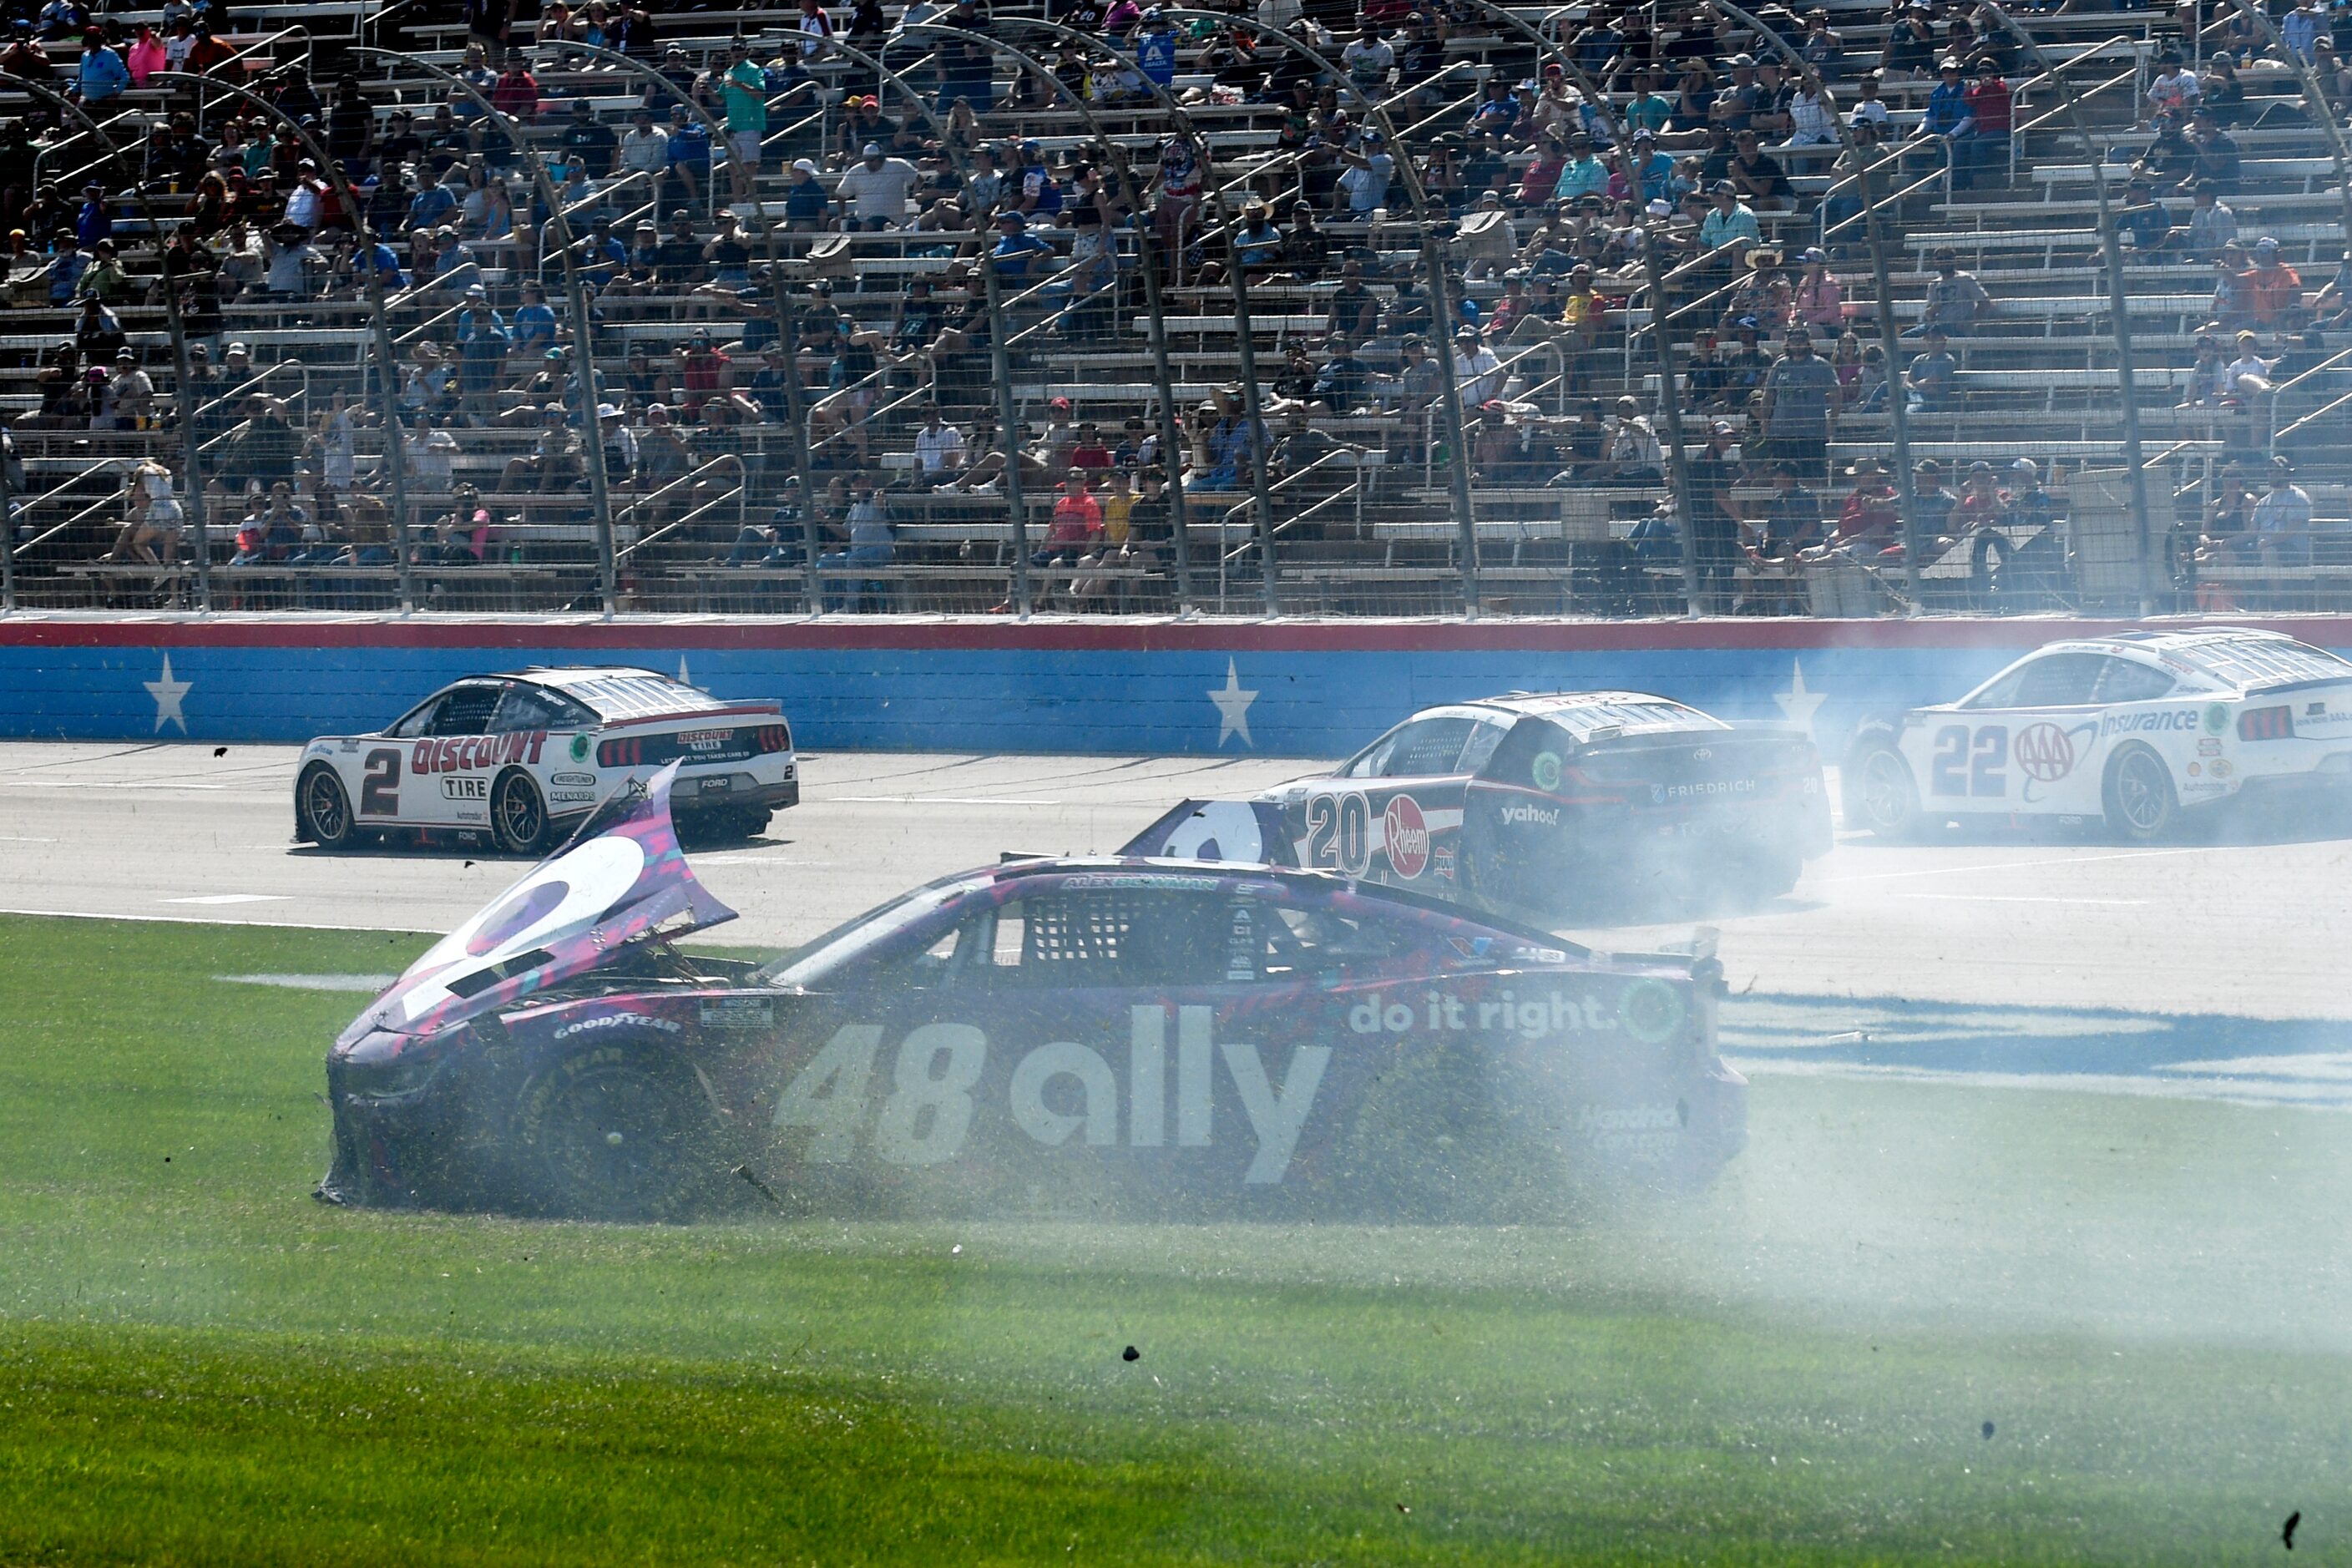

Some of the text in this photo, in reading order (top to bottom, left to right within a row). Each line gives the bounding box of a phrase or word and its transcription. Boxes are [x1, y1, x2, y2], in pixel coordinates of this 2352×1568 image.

[677, 730, 734, 744] DISCOUNT
[2100, 710, 2198, 737] Insurance
[412, 730, 548, 775] DISCOUNT
[692, 741, 721, 751] TIRE
[2017, 722, 2071, 781] AAA
[784, 765, 793, 780] 2
[1930, 725, 2007, 797] 22
[360, 747, 402, 817] 2
[445, 779, 486, 797] TIRE
[701, 778, 728, 789] FORD
[1667, 780, 1755, 798] FRIEDRICH
[1803, 777, 1818, 794] 20
[550, 792, 594, 802] MENARDS
[1501, 804, 1560, 826] yahoo!
[1308, 790, 1370, 876] 20
[1386, 798, 1428, 865] Rheem
[554, 1012, 682, 1039] GOODYEAR
[1348, 989, 1618, 1039] do it right.
[772, 1022, 988, 1166] 48
[1010, 1004, 1333, 1184] ally
